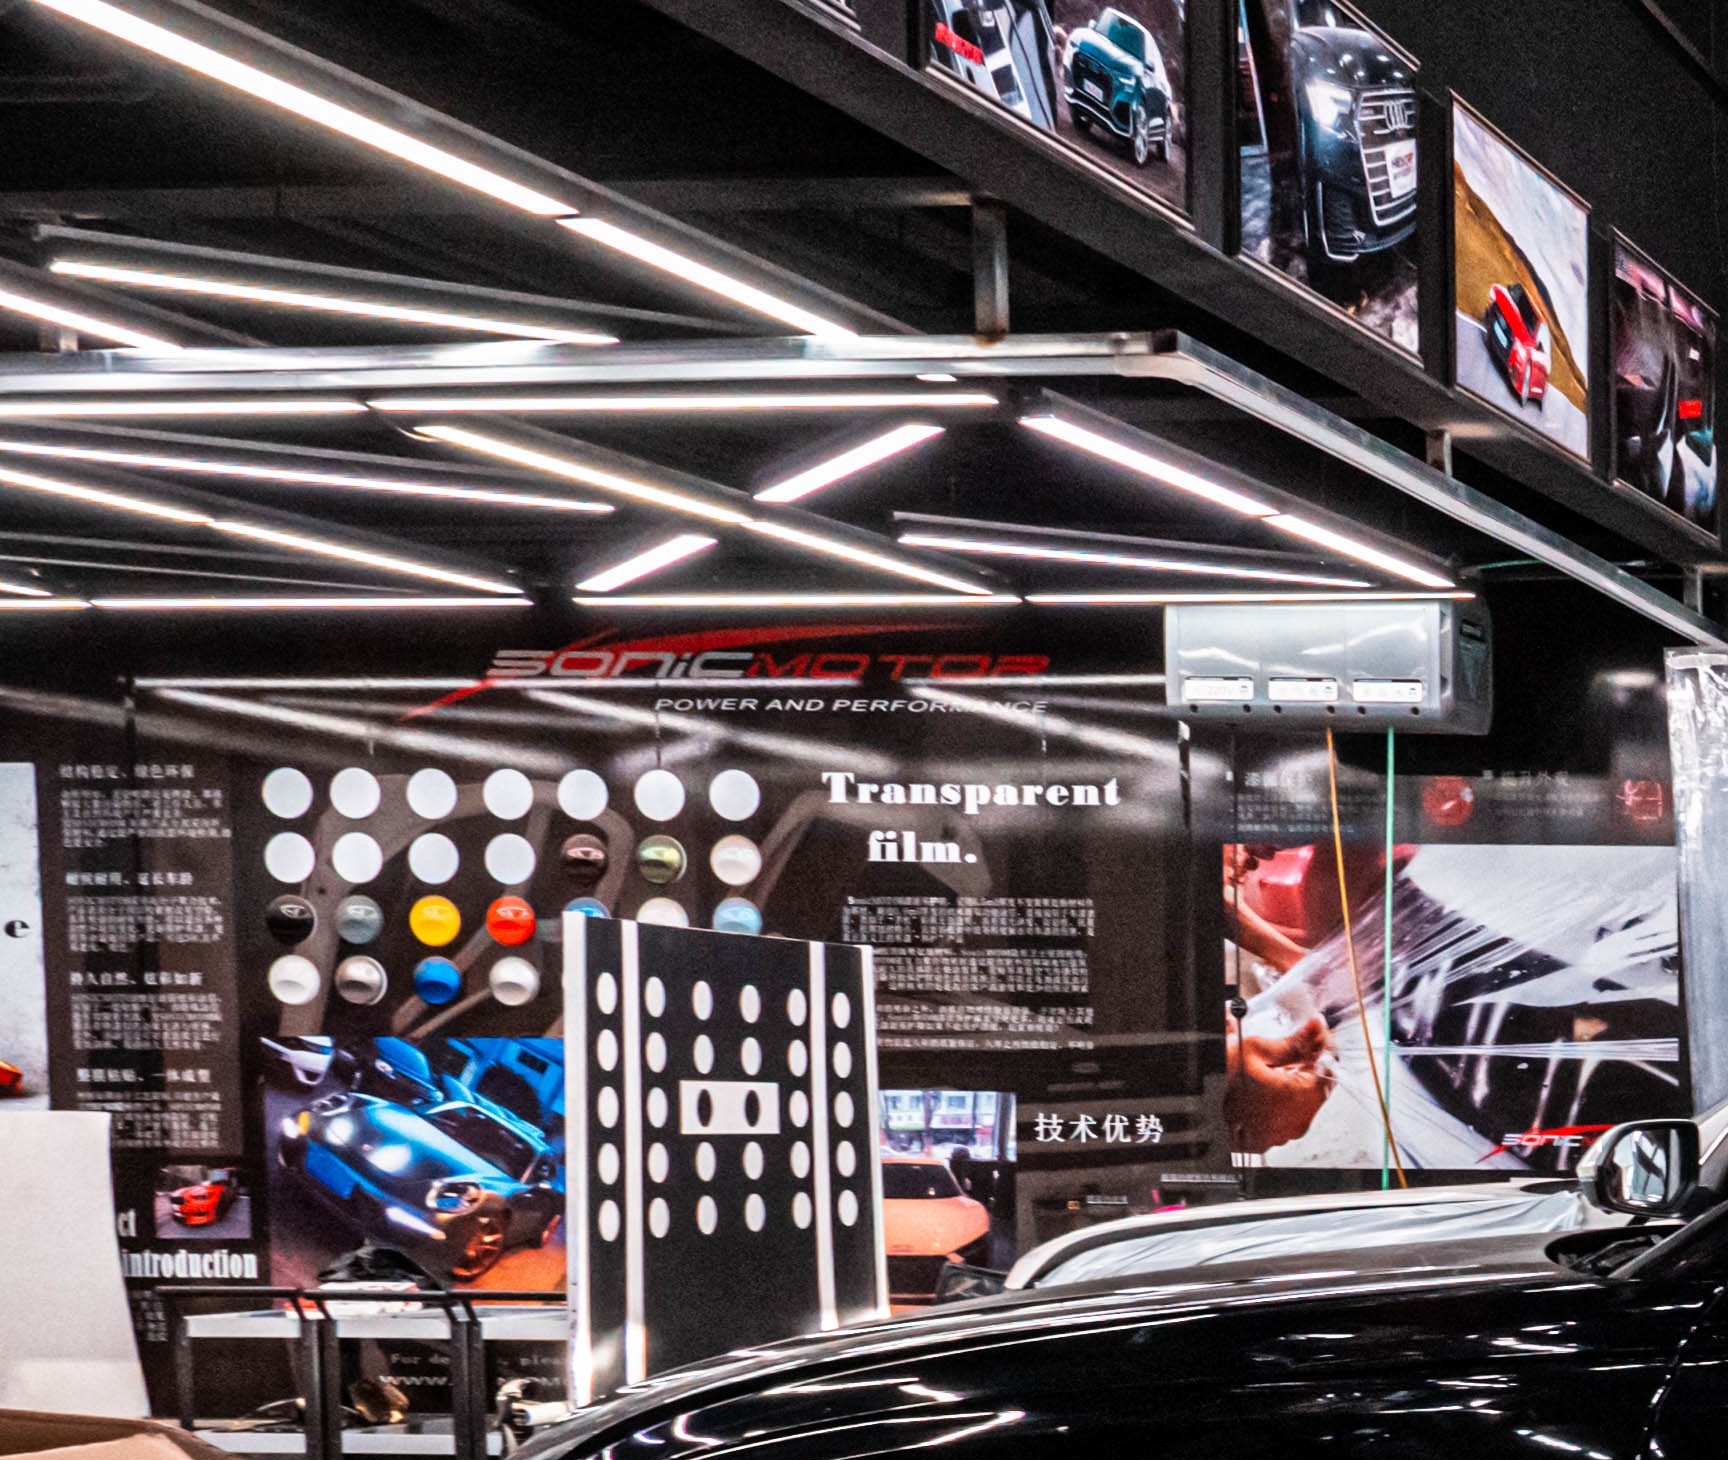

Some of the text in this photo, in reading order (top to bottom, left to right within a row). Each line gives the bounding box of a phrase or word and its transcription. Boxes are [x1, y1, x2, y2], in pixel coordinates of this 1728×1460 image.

[656, 698, 1048, 715] POWER AND PERFORMANCE
[821, 772, 1121, 815] Transparent
[867, 830, 977, 863] film.
[1034, 1112, 1165, 1144] 技术优势
[121, 1249, 259, 1279] introduction
